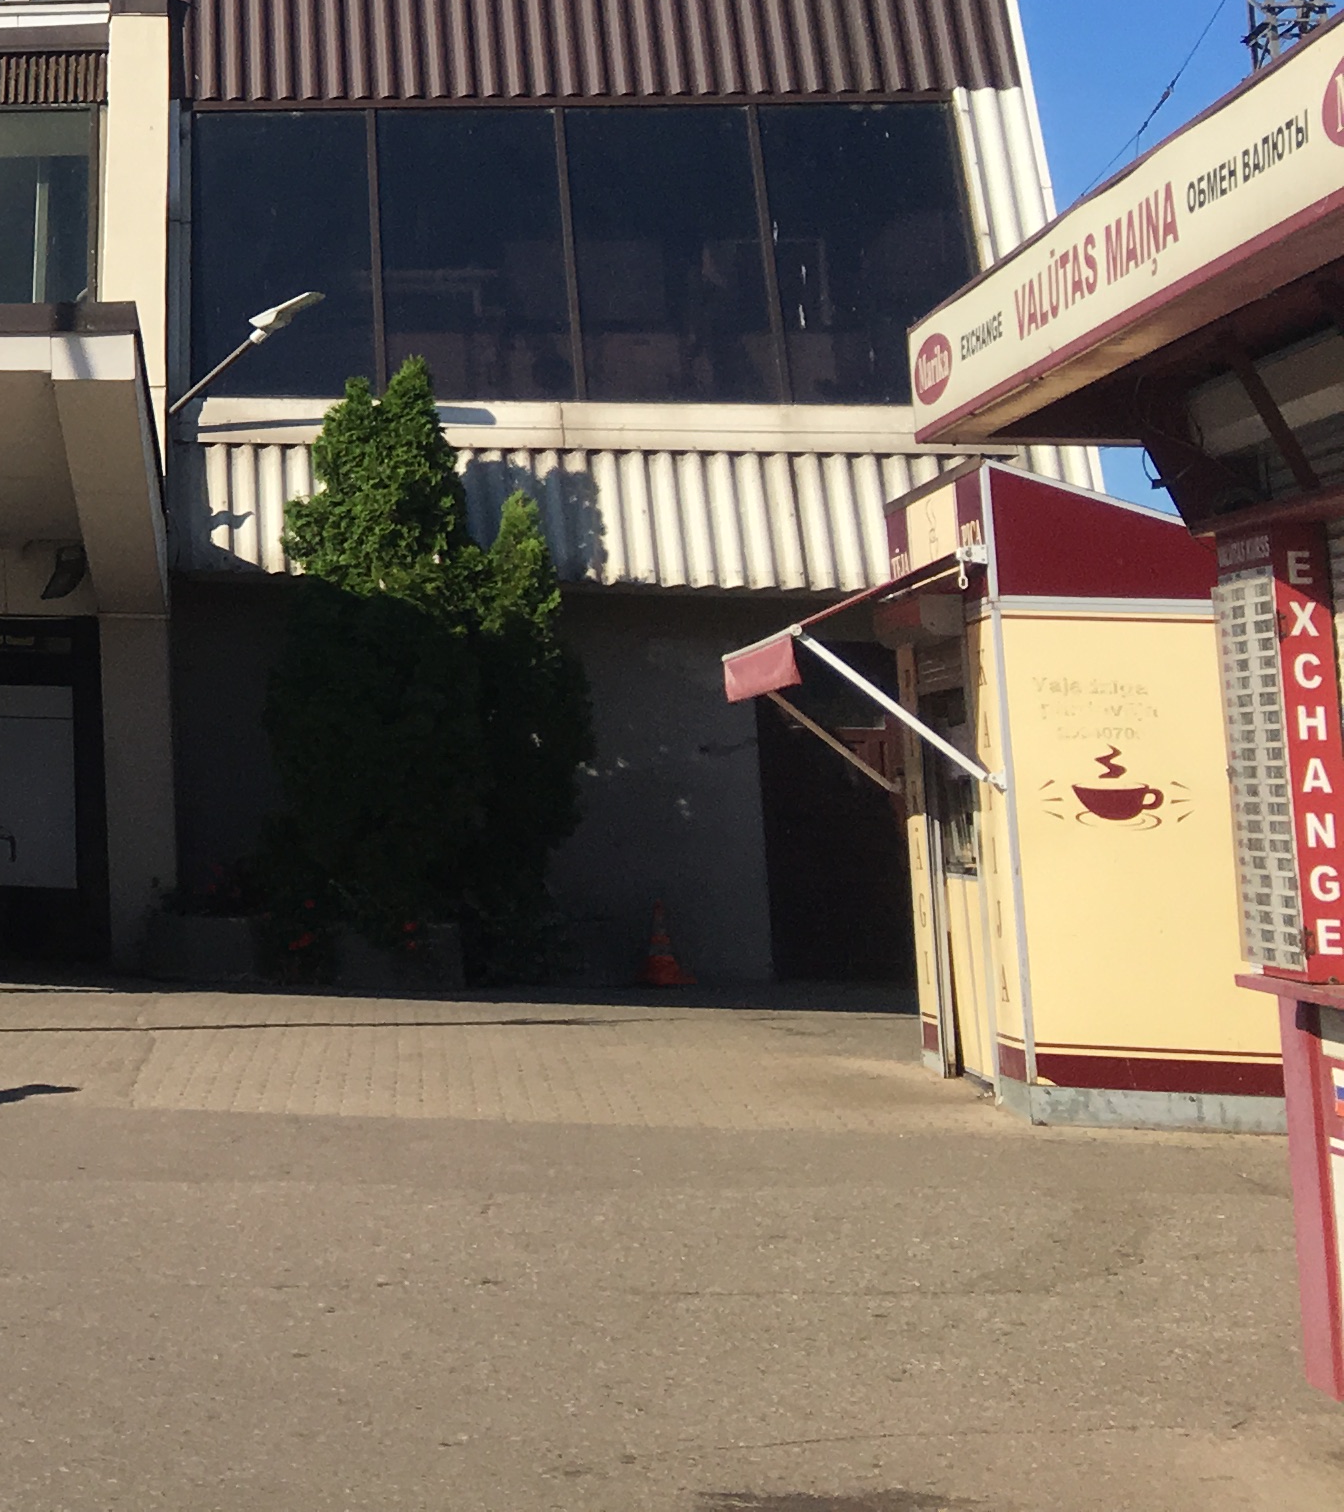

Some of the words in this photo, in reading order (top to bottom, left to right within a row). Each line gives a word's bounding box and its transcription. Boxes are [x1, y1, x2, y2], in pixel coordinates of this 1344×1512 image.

[1187, 156, 1238, 214] ОБМЕН
[1242, 109, 1309, 185] ВАЛЮТЫ
[1014, 233, 1098, 341] VALŪTAS
[1104, 181, 1180, 286] MAIŅA
[960, 311, 1003, 361] EXCHANGE
[1287, 550, 1344, 955] EXCHANGE
